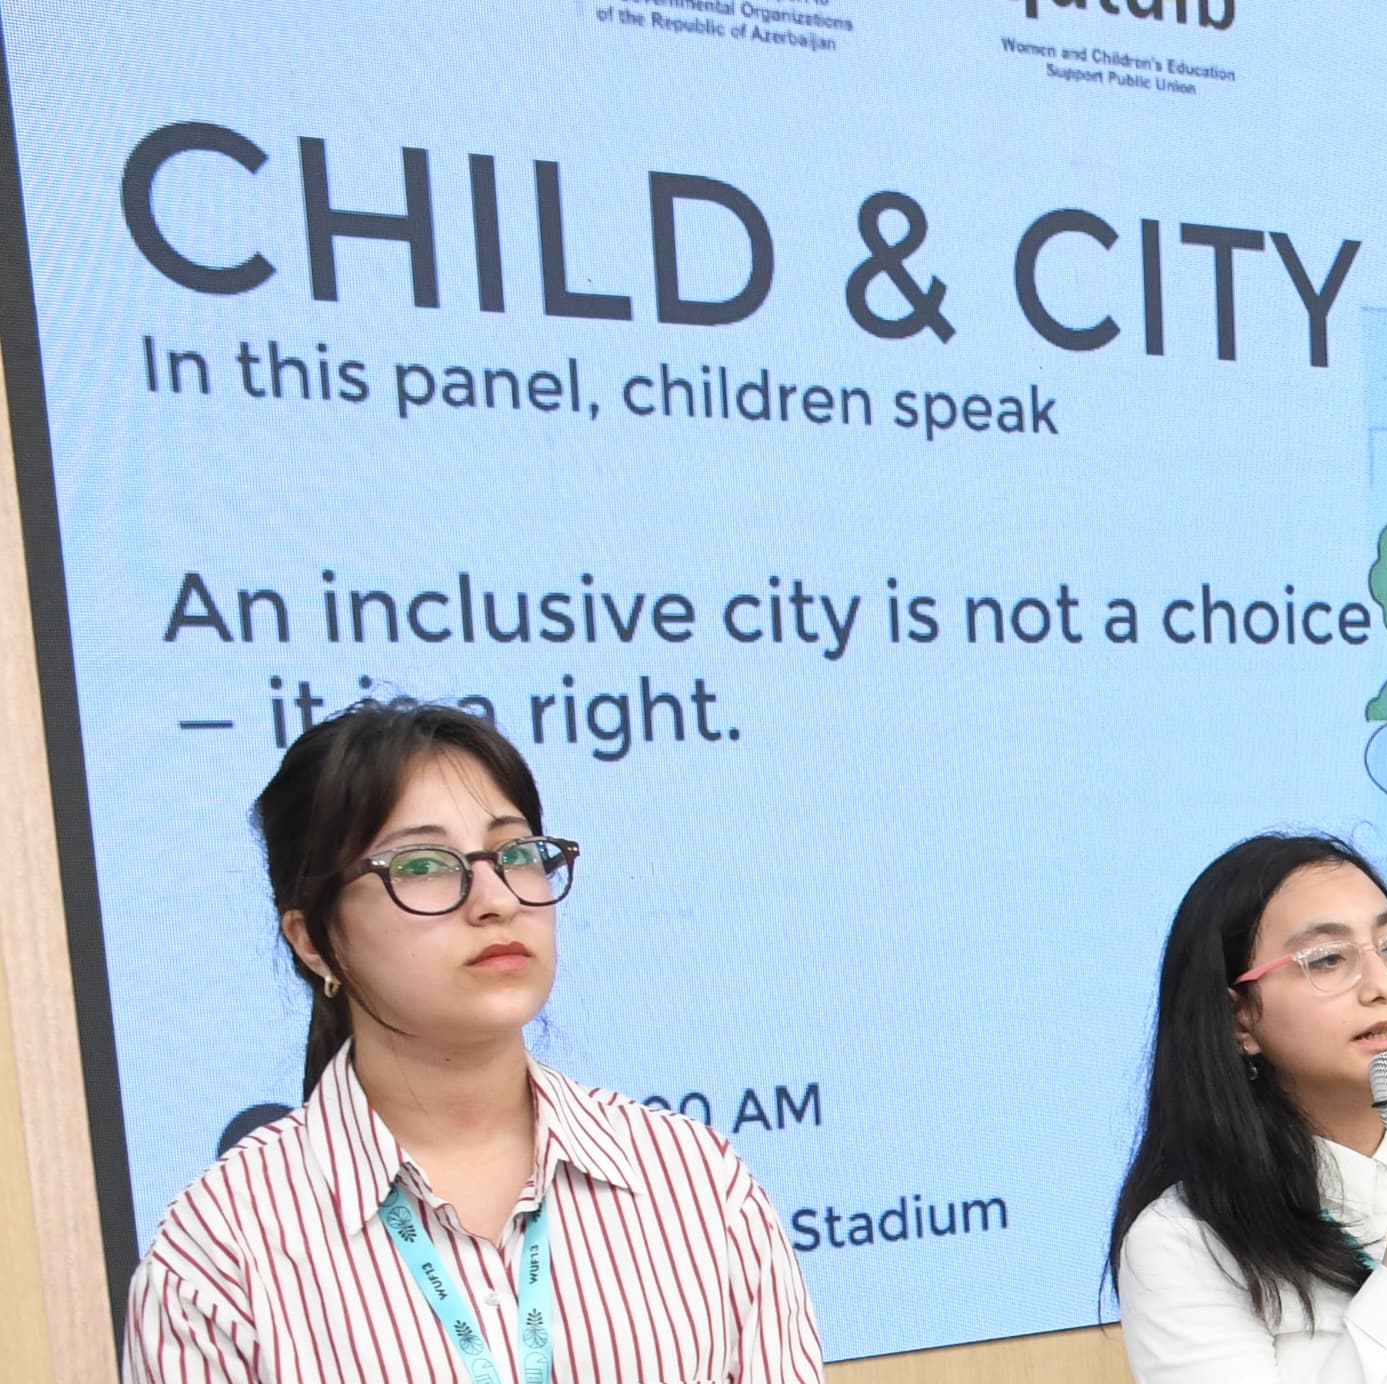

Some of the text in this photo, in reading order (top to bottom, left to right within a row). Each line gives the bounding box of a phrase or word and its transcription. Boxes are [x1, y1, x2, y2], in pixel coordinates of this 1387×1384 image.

[596, 7, 837, 52] of the Republic of Azerbaijan
[1001, 36, 1236, 81] Women and Children's Education
[1046, 63, 1197, 95] Support Public Union
[121, 121, 1361, 367] CHILD & CITY
[144, 336, 1057, 440] In this panel, children speak
[164, 570, 1375, 660] An inclusive city is not a choice
[271, 675, 323, 748] it
[531, 675, 739, 762] right.
[733, 1083, 821, 1133] AM
[792, 1193, 1009, 1253] Stadium
[420, 1261, 447, 1302] WUF13
[529, 1244, 539, 1285] WUF13
